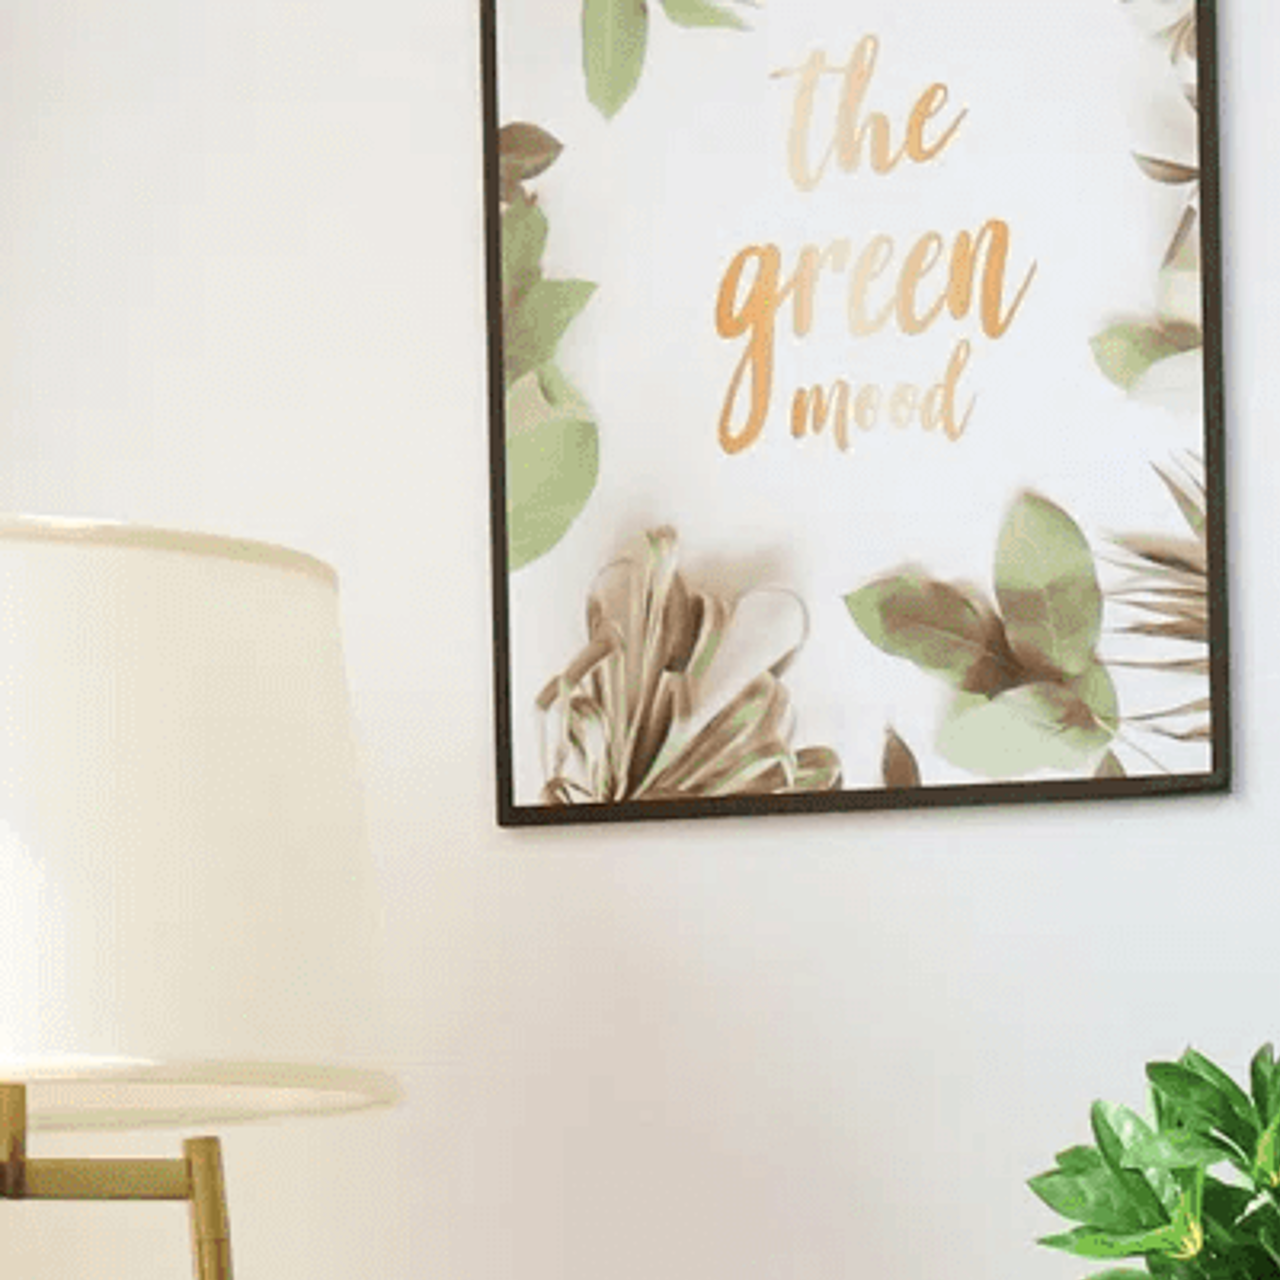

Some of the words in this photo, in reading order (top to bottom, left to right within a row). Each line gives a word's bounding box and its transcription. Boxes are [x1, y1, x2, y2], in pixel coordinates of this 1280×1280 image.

[770, 34, 969, 191] the
[715, 219, 1037, 454] green
[791, 339, 975, 451] mood
